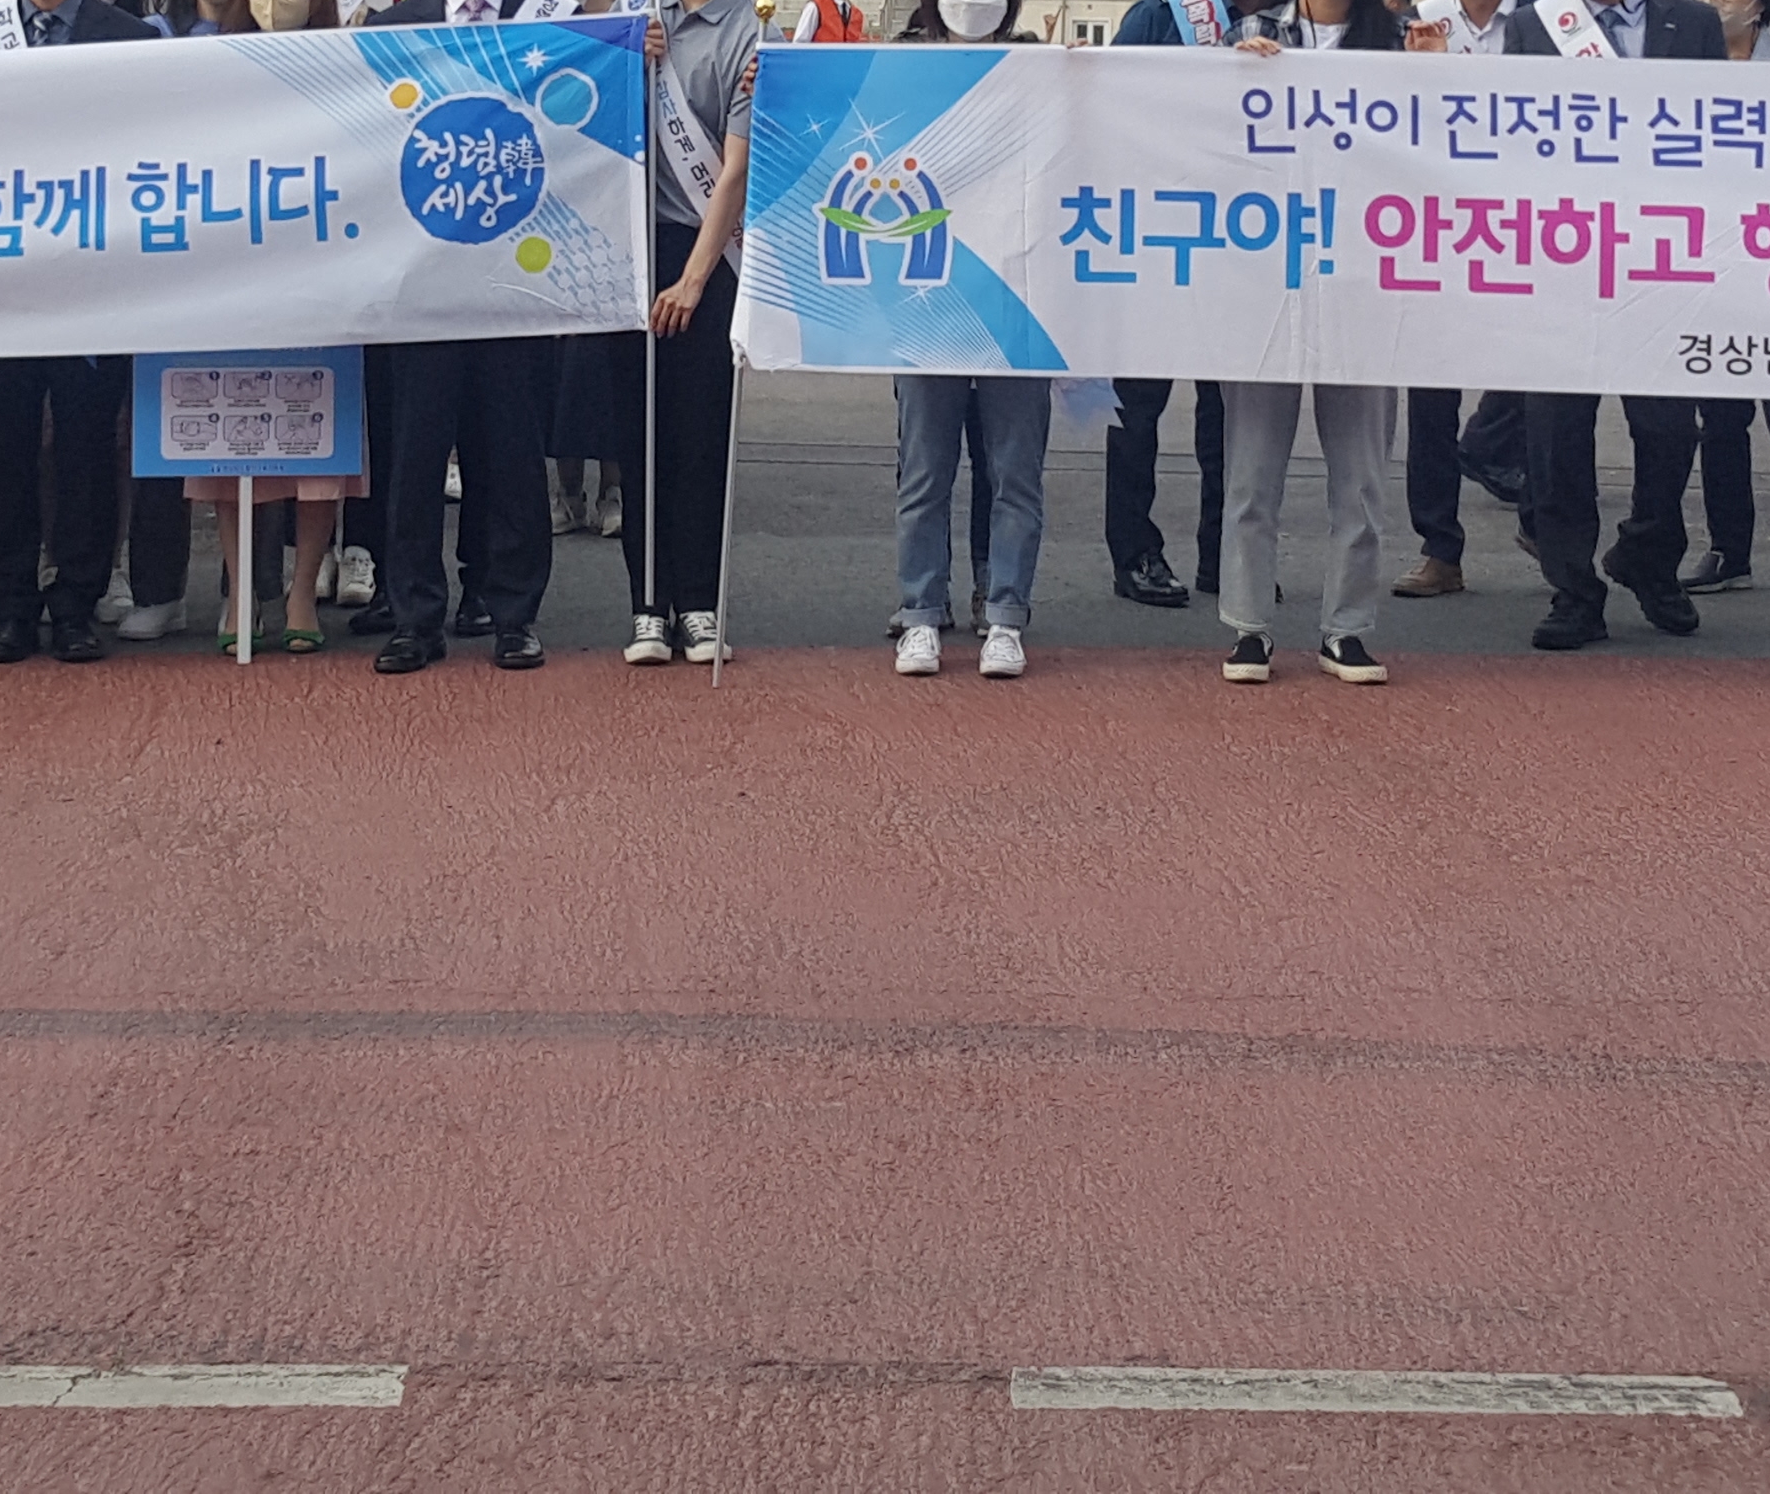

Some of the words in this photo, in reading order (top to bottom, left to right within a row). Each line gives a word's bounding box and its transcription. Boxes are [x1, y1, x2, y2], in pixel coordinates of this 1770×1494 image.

[1241, 85, 1422, 154] 인성이
[1441, 93, 1629, 164] 진정한
[126, 155, 361, 255] 합니다.
[421, 174, 518, 228] 세상
[1058, 185, 1337, 290] 친구야!
[1363, 193, 1716, 300] 안전하고
